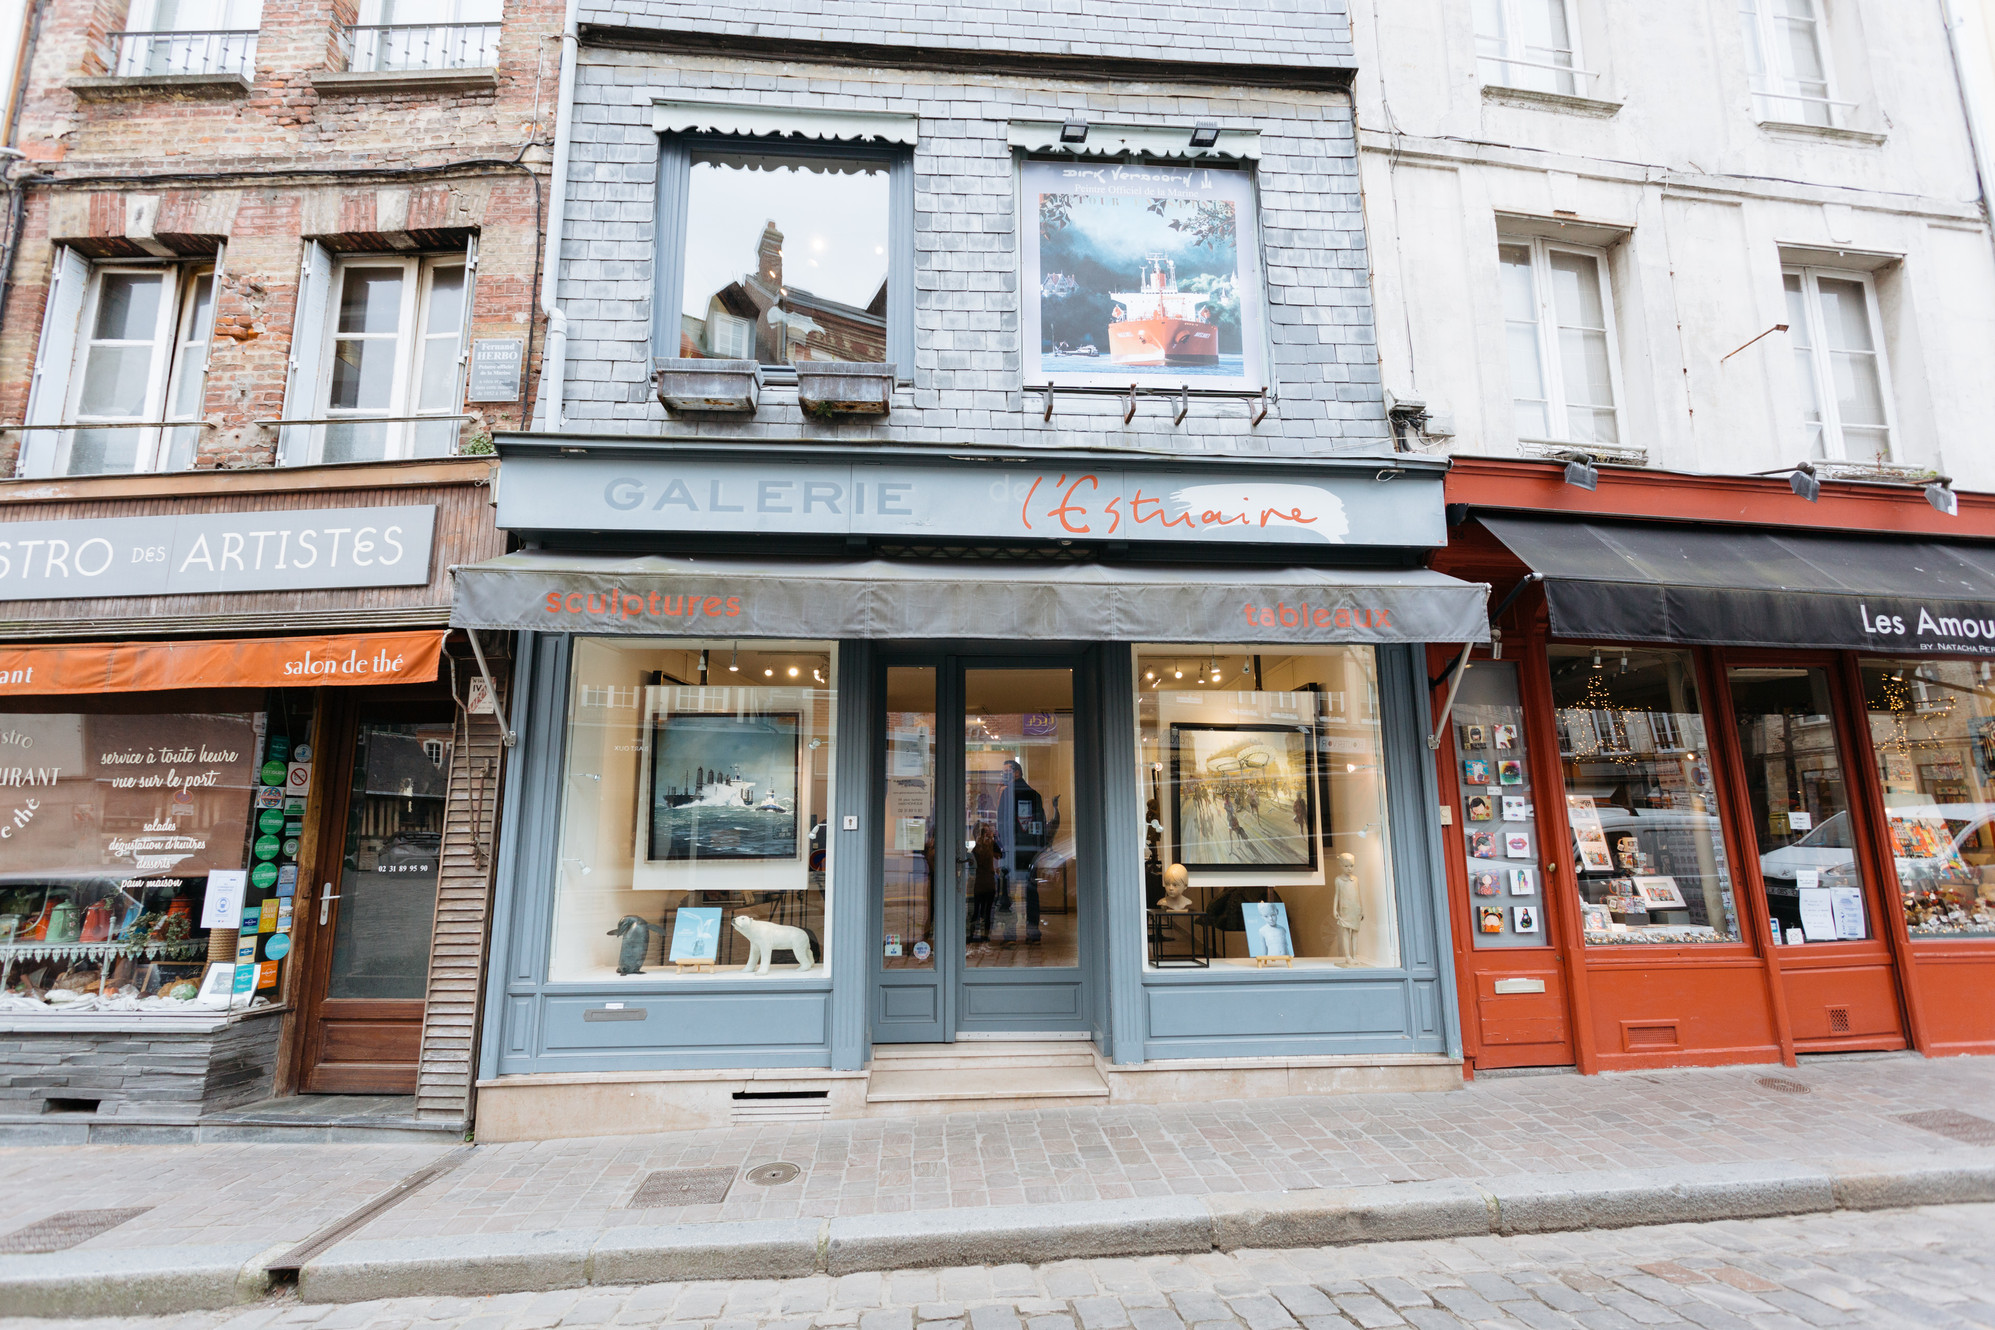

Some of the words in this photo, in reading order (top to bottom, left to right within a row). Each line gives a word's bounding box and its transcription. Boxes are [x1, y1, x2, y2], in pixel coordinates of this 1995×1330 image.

[1074, 183, 1106, 194] Peintre
[1108, 185, 1142, 196] Officiel
[1144, 187, 1155, 196] de
[1157, 188, 1166, 196] la
[1169, 189, 1199, 198] Marine
[477, 352, 518, 360] HERBO
[603, 476, 913, 516] GALERIE
[131, 546, 166, 563] DES
[179, 526, 403, 573] ARTISTES
[545, 588, 741, 621] sculptures
[1243, 602, 1392, 628] tableaux
[1860, 604, 1906, 635] Les
[1937, 643, 1978, 653] NATACHA
[284, 650, 336, 676] salon
[342, 650, 372, 674] de
[373, 648, 404, 674] thé
[0, 666, 33, 684] ant
[101, 747, 144, 765] service
[146, 747, 157, 764] à
[158, 747, 196, 763] toute
[199, 744, 239, 763] heure
[112, 777, 139, 788] vue
[138, 774, 164, 788] sur
[166, 768, 182, 788] le
[182, 770, 221, 795] port
[143, 818, 176, 832] salades
[108, 837, 163, 857] dégustation
[136, 856, 171, 869] desserts
[120, 876, 144, 893] pain
[145, 876, 183, 888] maison
